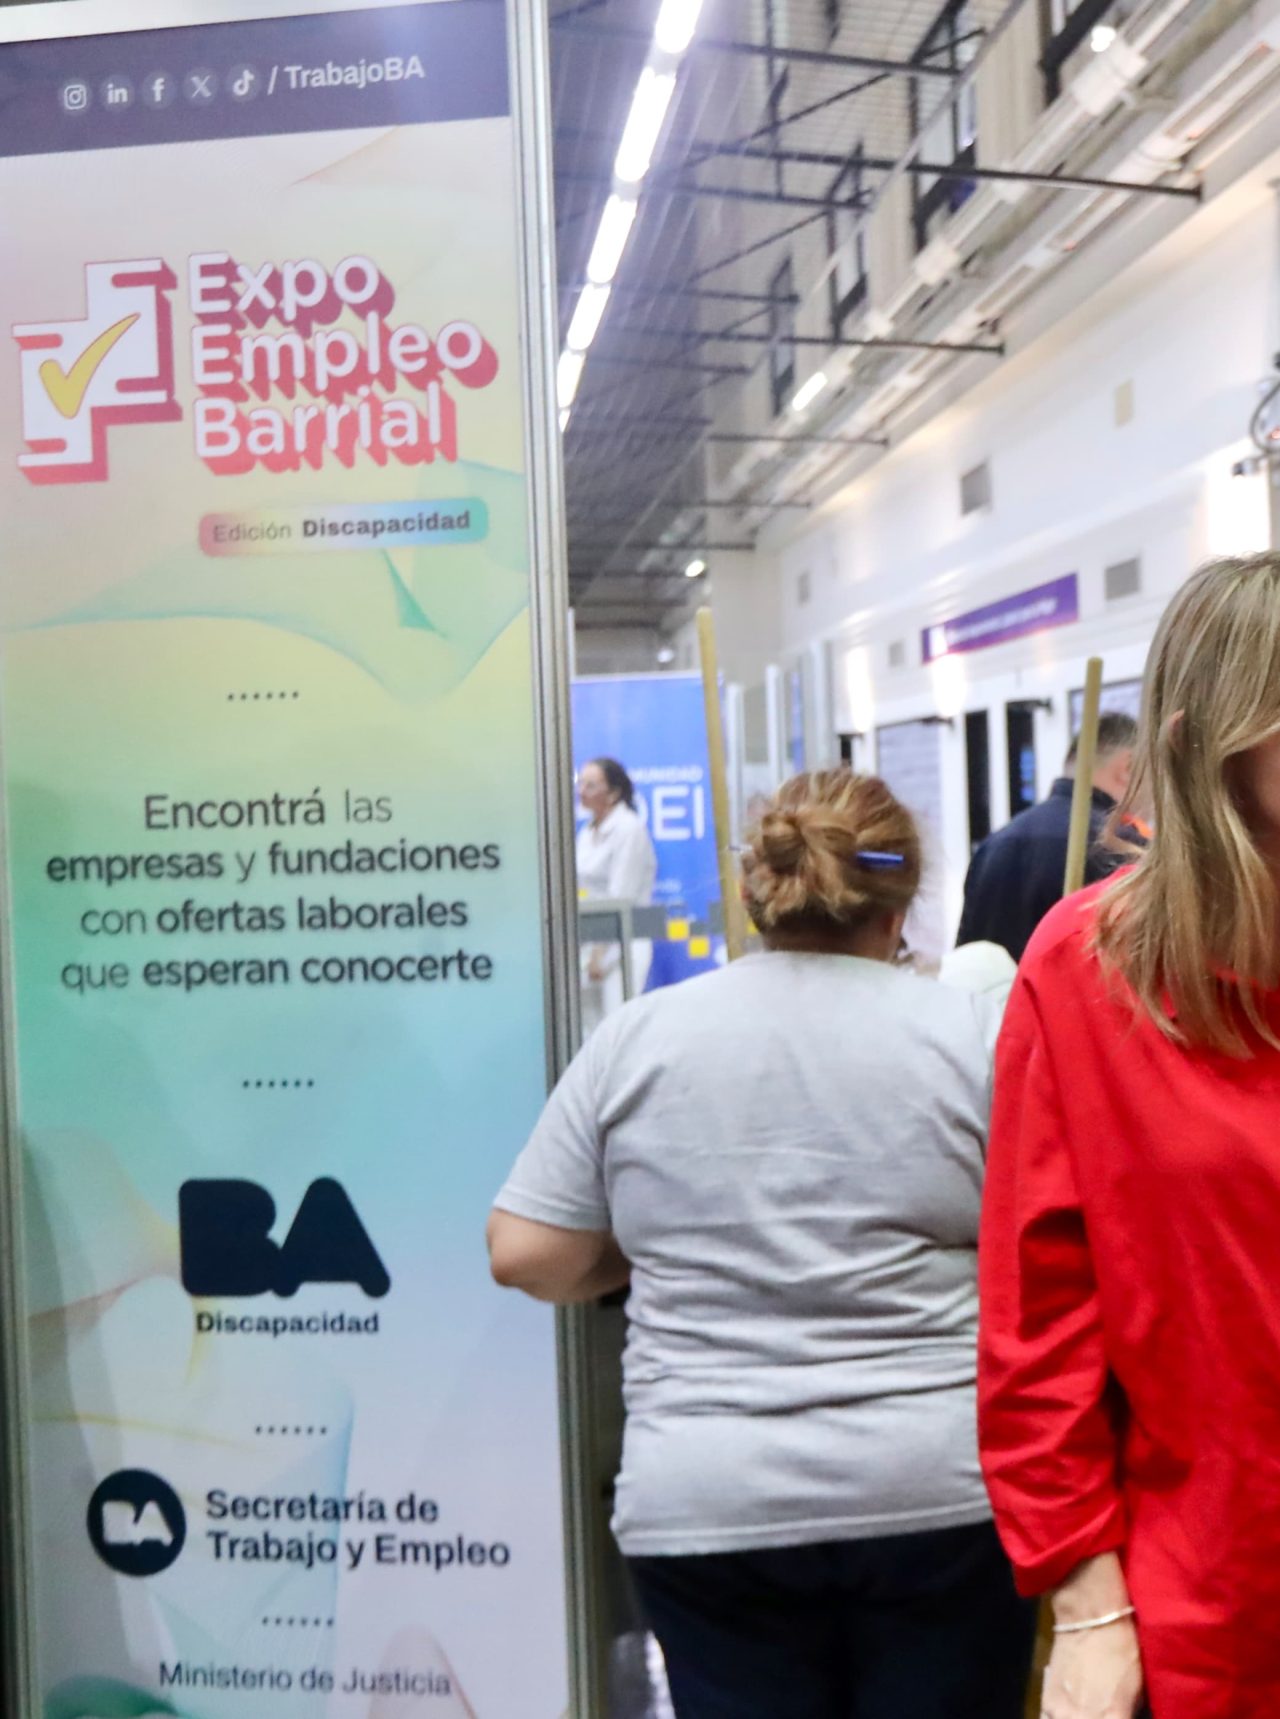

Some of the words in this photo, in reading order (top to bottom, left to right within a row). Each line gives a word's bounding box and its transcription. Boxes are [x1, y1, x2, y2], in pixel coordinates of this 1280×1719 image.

[188, 252, 380, 318] Expo
[192, 311, 482, 390] Empleo
[194, 381, 442, 457] Barrial
[213, 520, 292, 543] Edición
[302, 508, 471, 538] Discapacidad
[144, 787, 326, 830] Encontrá
[345, 789, 393, 823] las
[46, 848, 224, 887] empresas
[235, 850, 256, 882] y
[267, 838, 500, 875] fundaciones
[80, 904, 147, 936] con
[157, 898, 286, 933] ofertas
[298, 894, 469, 930] laborales
[61, 961, 130, 996] que
[143, 953, 289, 991] esperan
[302, 949, 493, 983] conocerte
[178, 1176, 391, 1299] BA
[196, 1311, 380, 1337] Discapacidad
[102, 1500, 174, 1546] BA
[205, 1489, 386, 1522] Secretaría
[395, 1491, 439, 1524] de
[207, 1530, 337, 1569] Trabajo
[345, 1539, 366, 1569] y
[376, 1536, 511, 1571] Empleo
[159, 1660, 292, 1693] Ministerio
[299, 1667, 334, 1693] de
[342, 1669, 452, 1696] Justicia
